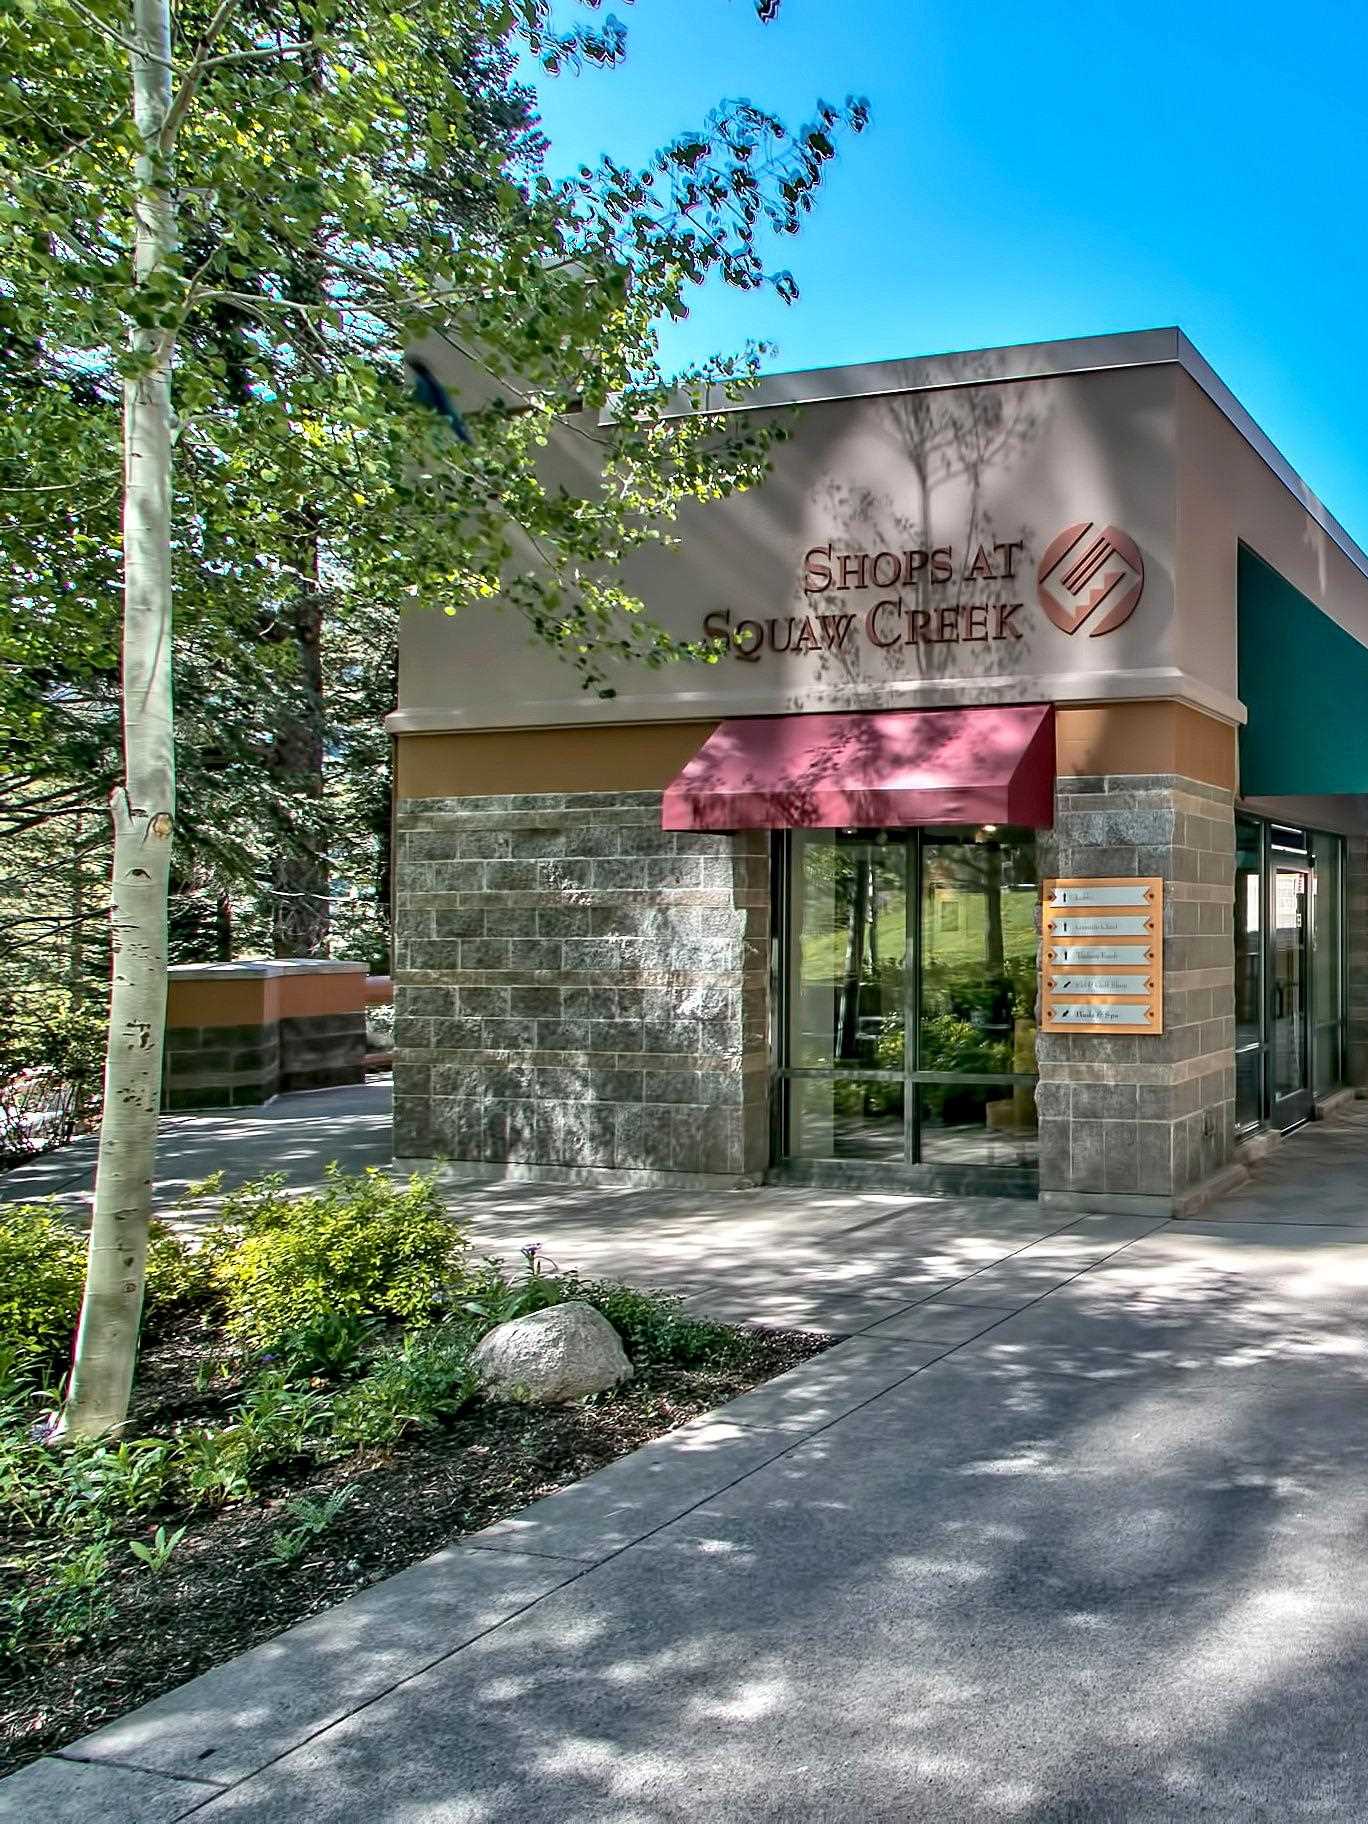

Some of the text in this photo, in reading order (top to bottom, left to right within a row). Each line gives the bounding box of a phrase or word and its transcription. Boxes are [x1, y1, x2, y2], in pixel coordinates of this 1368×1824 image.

[804, 540, 1023, 594] SHOPS AT
[703, 597, 1023, 662] SQUAW CREEK
